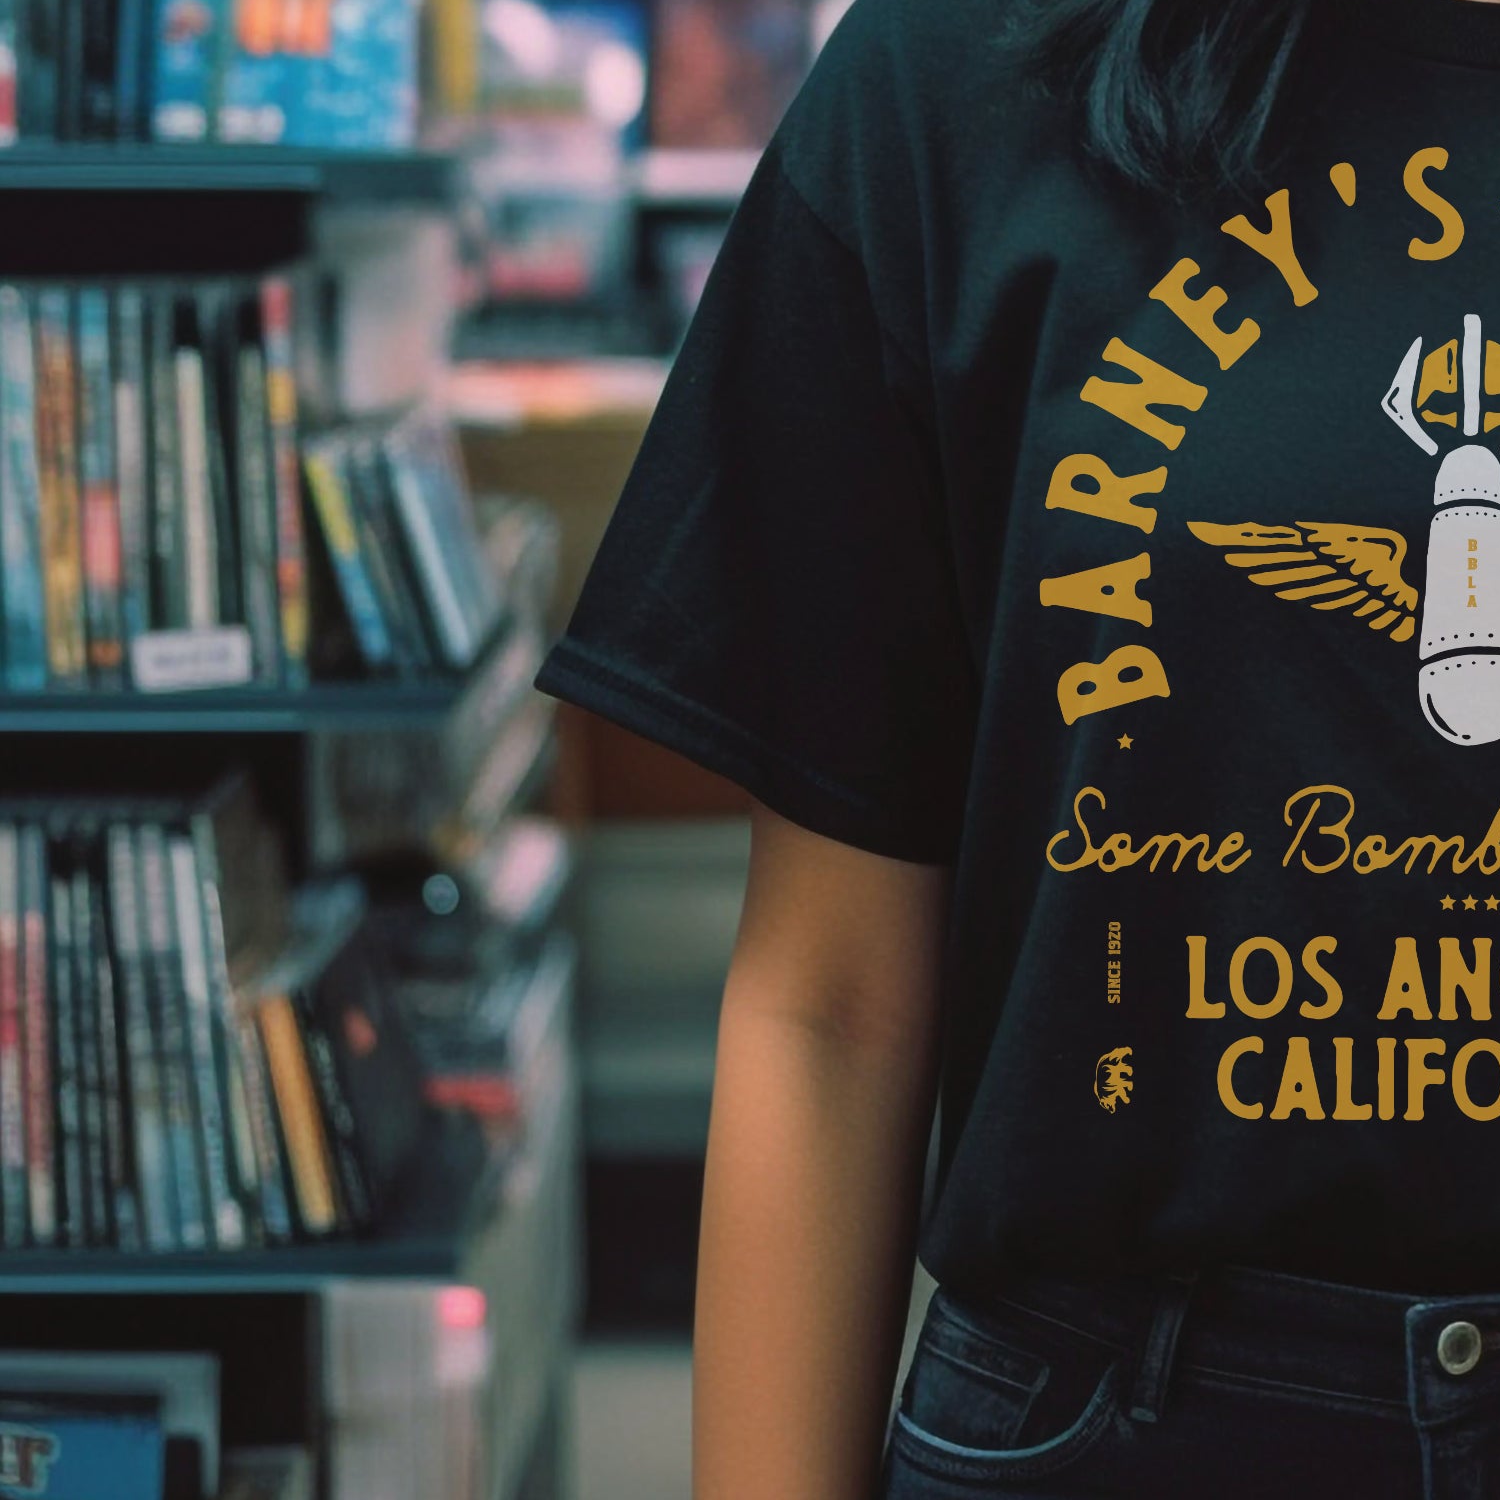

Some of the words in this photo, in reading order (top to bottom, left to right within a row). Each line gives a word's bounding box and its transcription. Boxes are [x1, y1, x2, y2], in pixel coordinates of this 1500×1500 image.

[1039, 146, 1465, 726] BARNEY'S
[1466, 538, 1478, 608] BBLA
[1045, 786, 1252, 874] Some
[1108, 921, 1122, 955] 1920
[1107, 961, 1121, 1004] SINCE
[1185, 935, 1344, 1020] LOS
